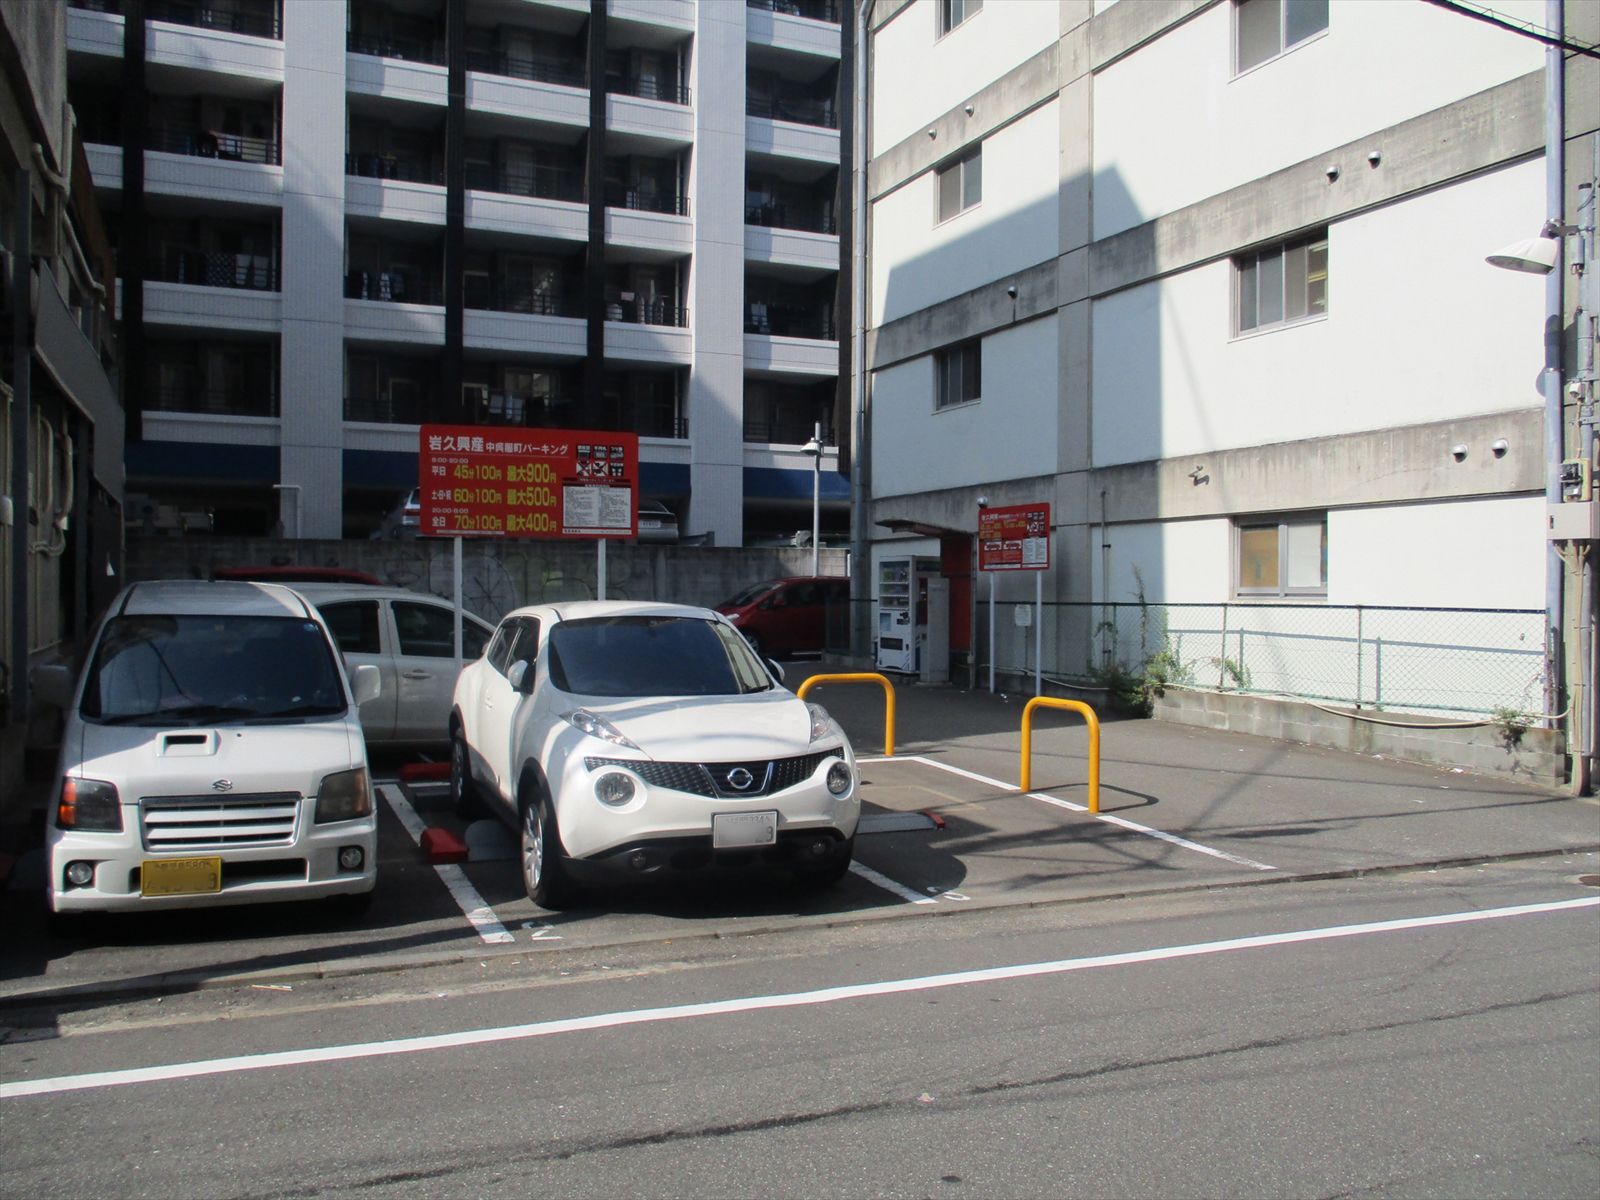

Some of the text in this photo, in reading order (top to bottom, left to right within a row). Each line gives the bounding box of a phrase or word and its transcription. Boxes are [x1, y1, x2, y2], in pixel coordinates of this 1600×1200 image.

[429, 436, 484, 452] 岩久興産
[432, 466, 446, 476] 平日
[507, 464, 556, 483] 最大900円
[507, 487, 556, 507] 最大500円
[432, 517, 446, 527] 全日
[507, 513, 556, 532] 最大400円
